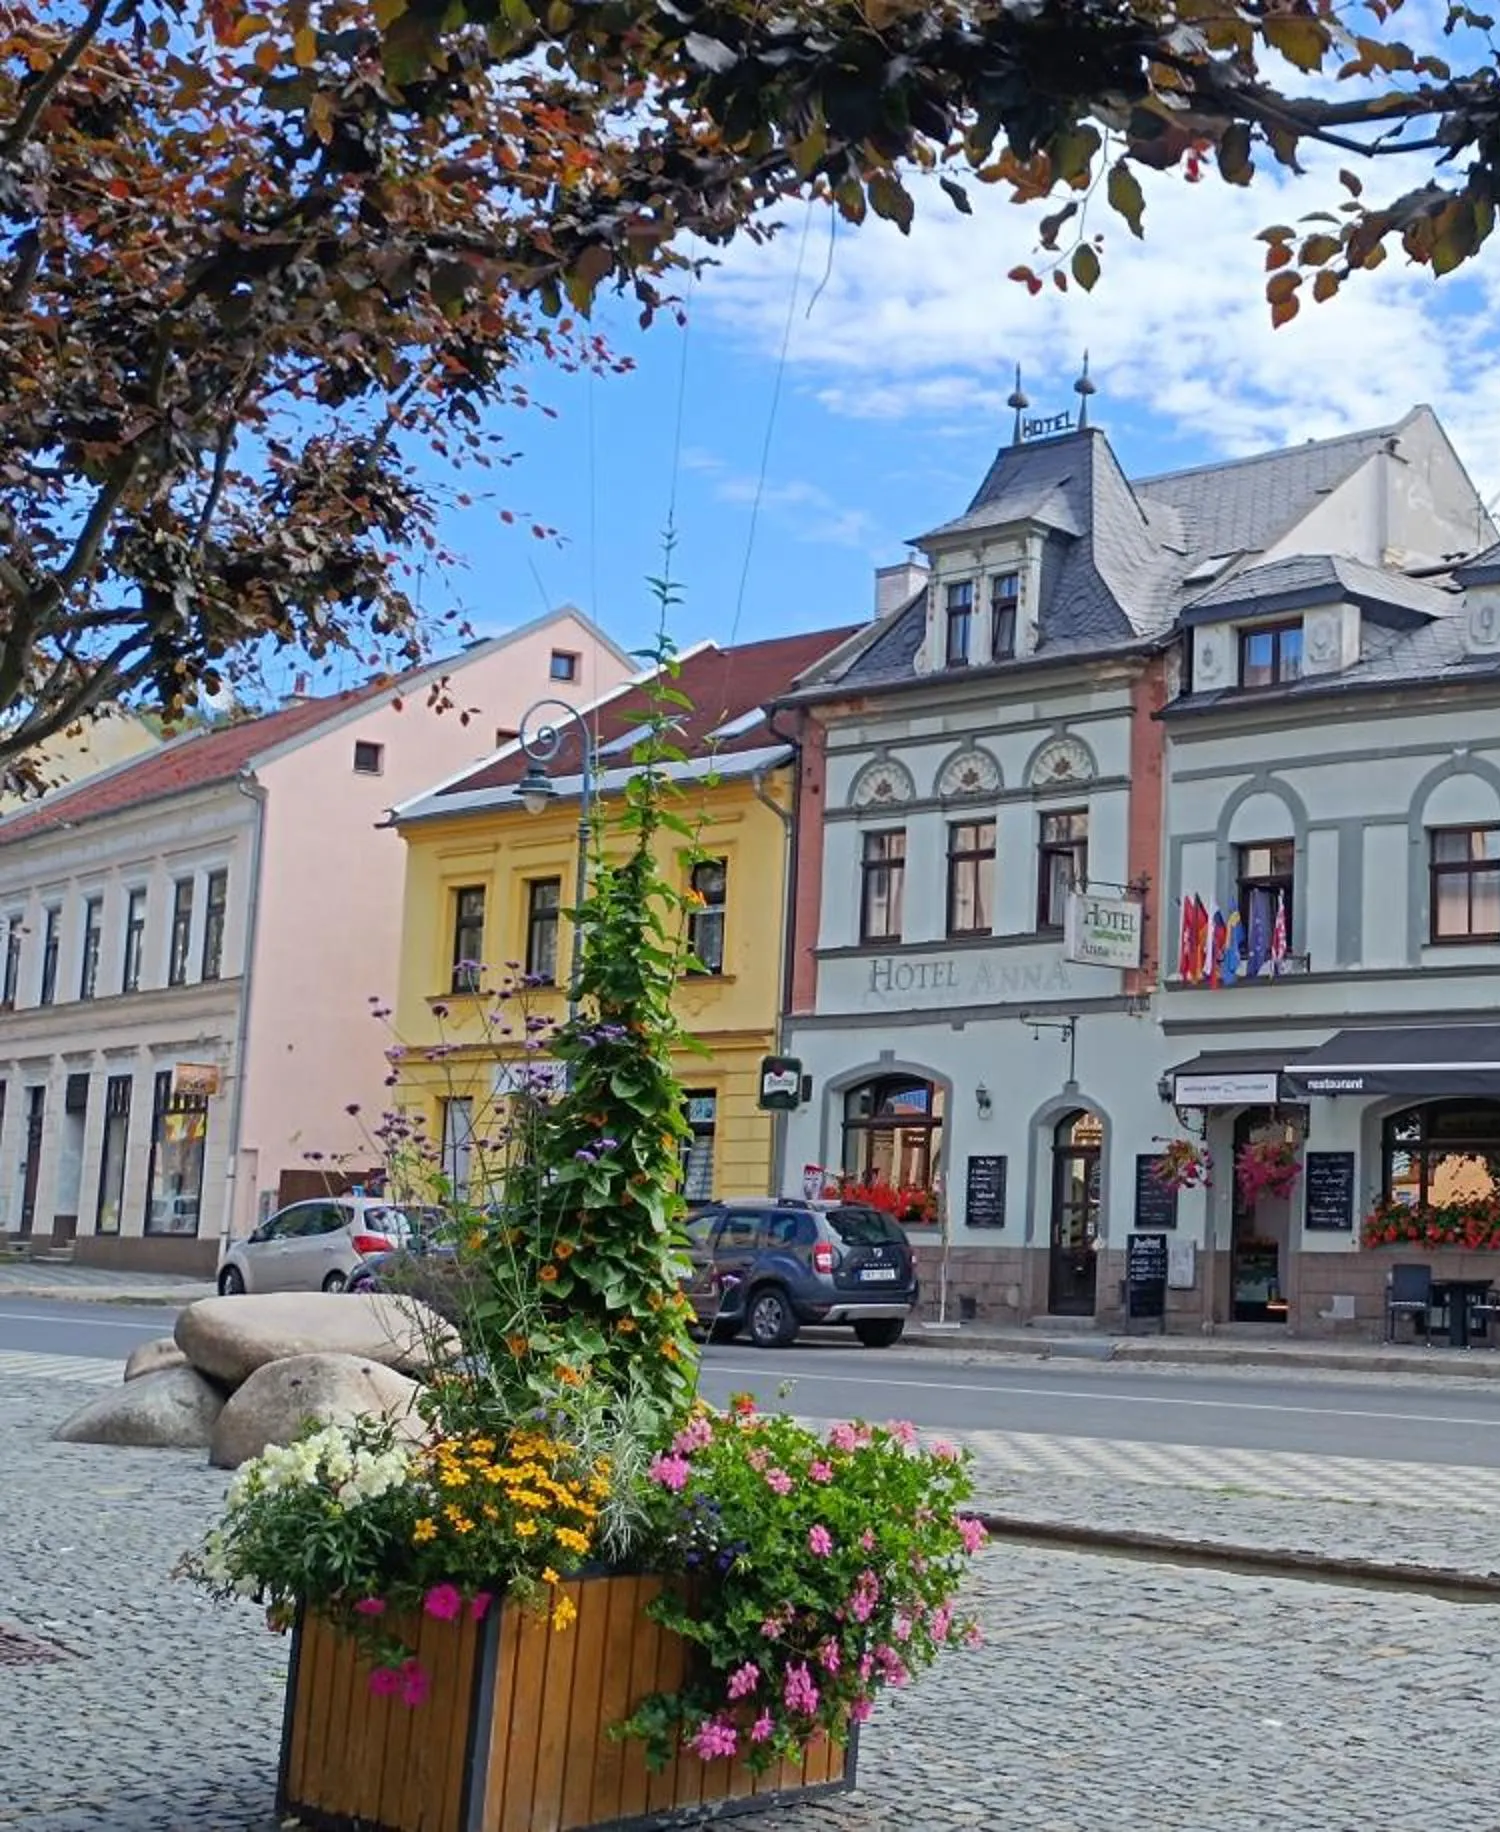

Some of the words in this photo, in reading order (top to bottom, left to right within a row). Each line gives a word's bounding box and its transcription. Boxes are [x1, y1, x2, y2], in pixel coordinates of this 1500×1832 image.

[1022, 410, 1076, 438] HOTEL
[1084, 903, 1137, 932] HOTEL
[869, 958, 958, 993] HOTEL
[971, 958, 1073, 996] ANNA
[1307, 1078, 1364, 1090] restaurant
